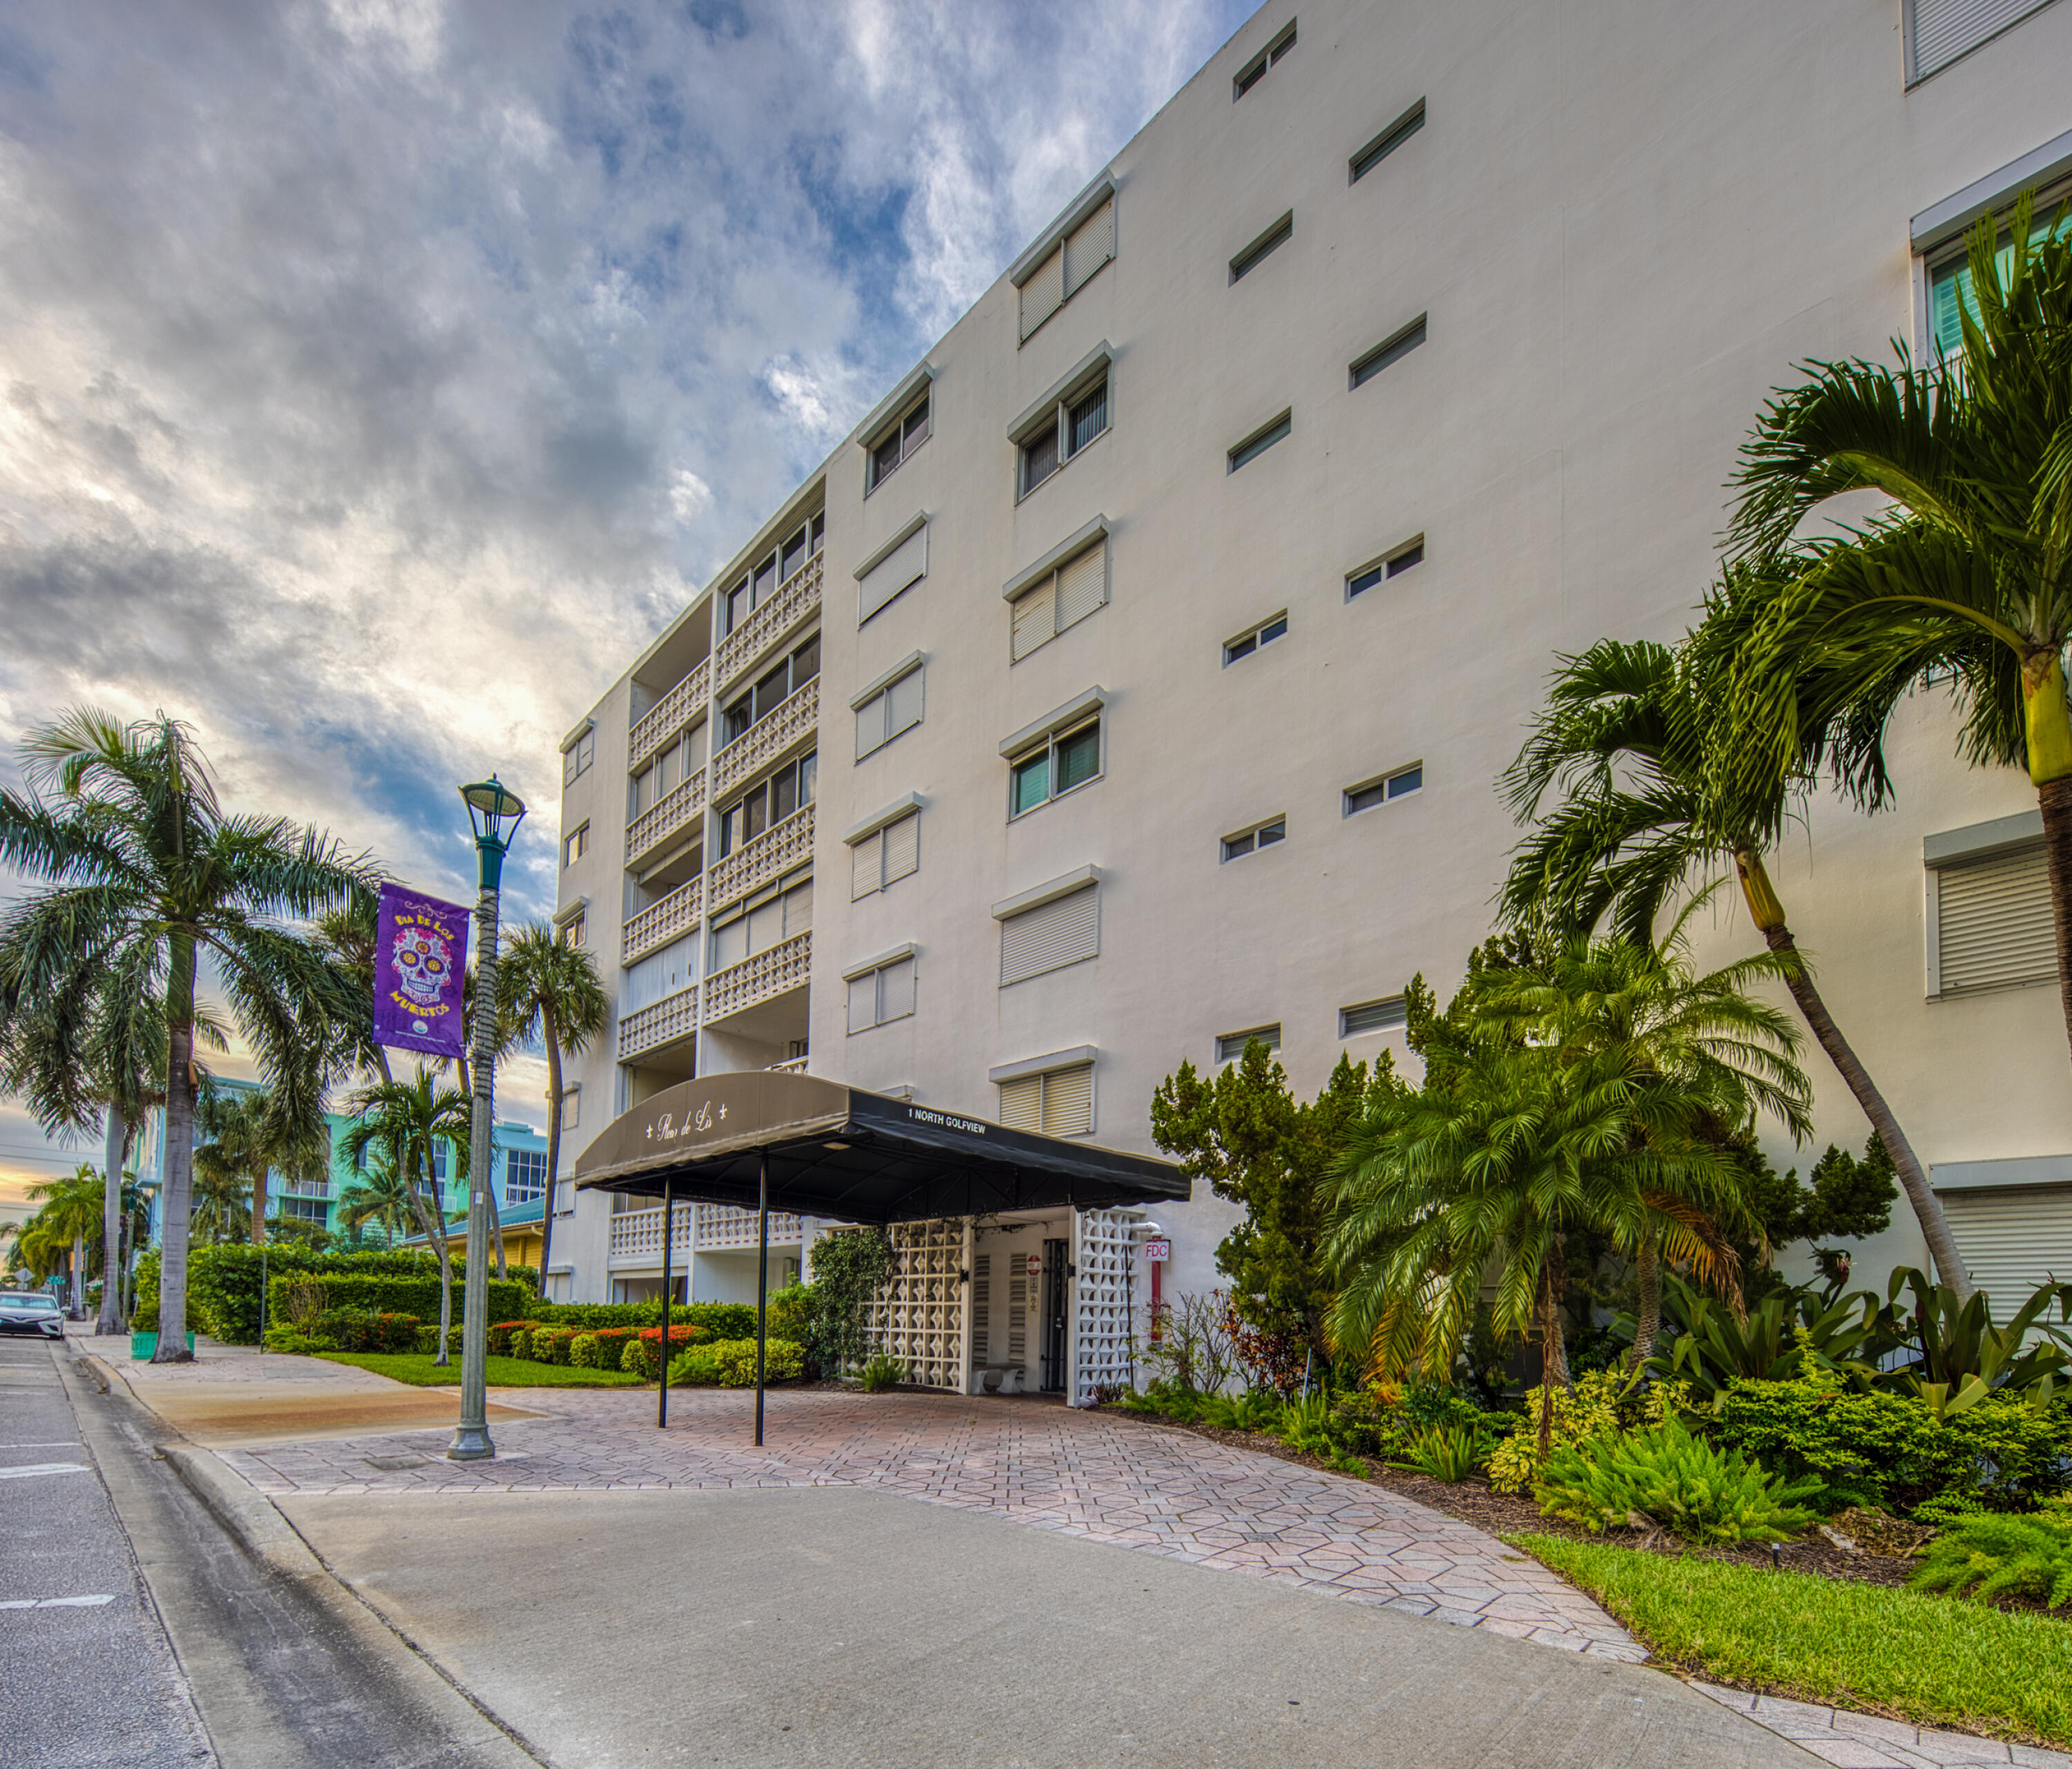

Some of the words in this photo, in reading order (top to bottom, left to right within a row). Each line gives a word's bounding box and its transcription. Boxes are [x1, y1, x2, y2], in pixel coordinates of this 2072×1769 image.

[417, 914, 431, 926] DE
[390, 991, 450, 1017] MUERTOS
[681, 1111, 691, 1136] de
[695, 1100, 712, 1131] Lis
[908, 1108, 912, 1118] 1
[914, 1109, 944, 1125] NORTH
[946, 1116, 986, 1134] GOLFVIEW
[1146, 1244, 1167, 1257] FDC
